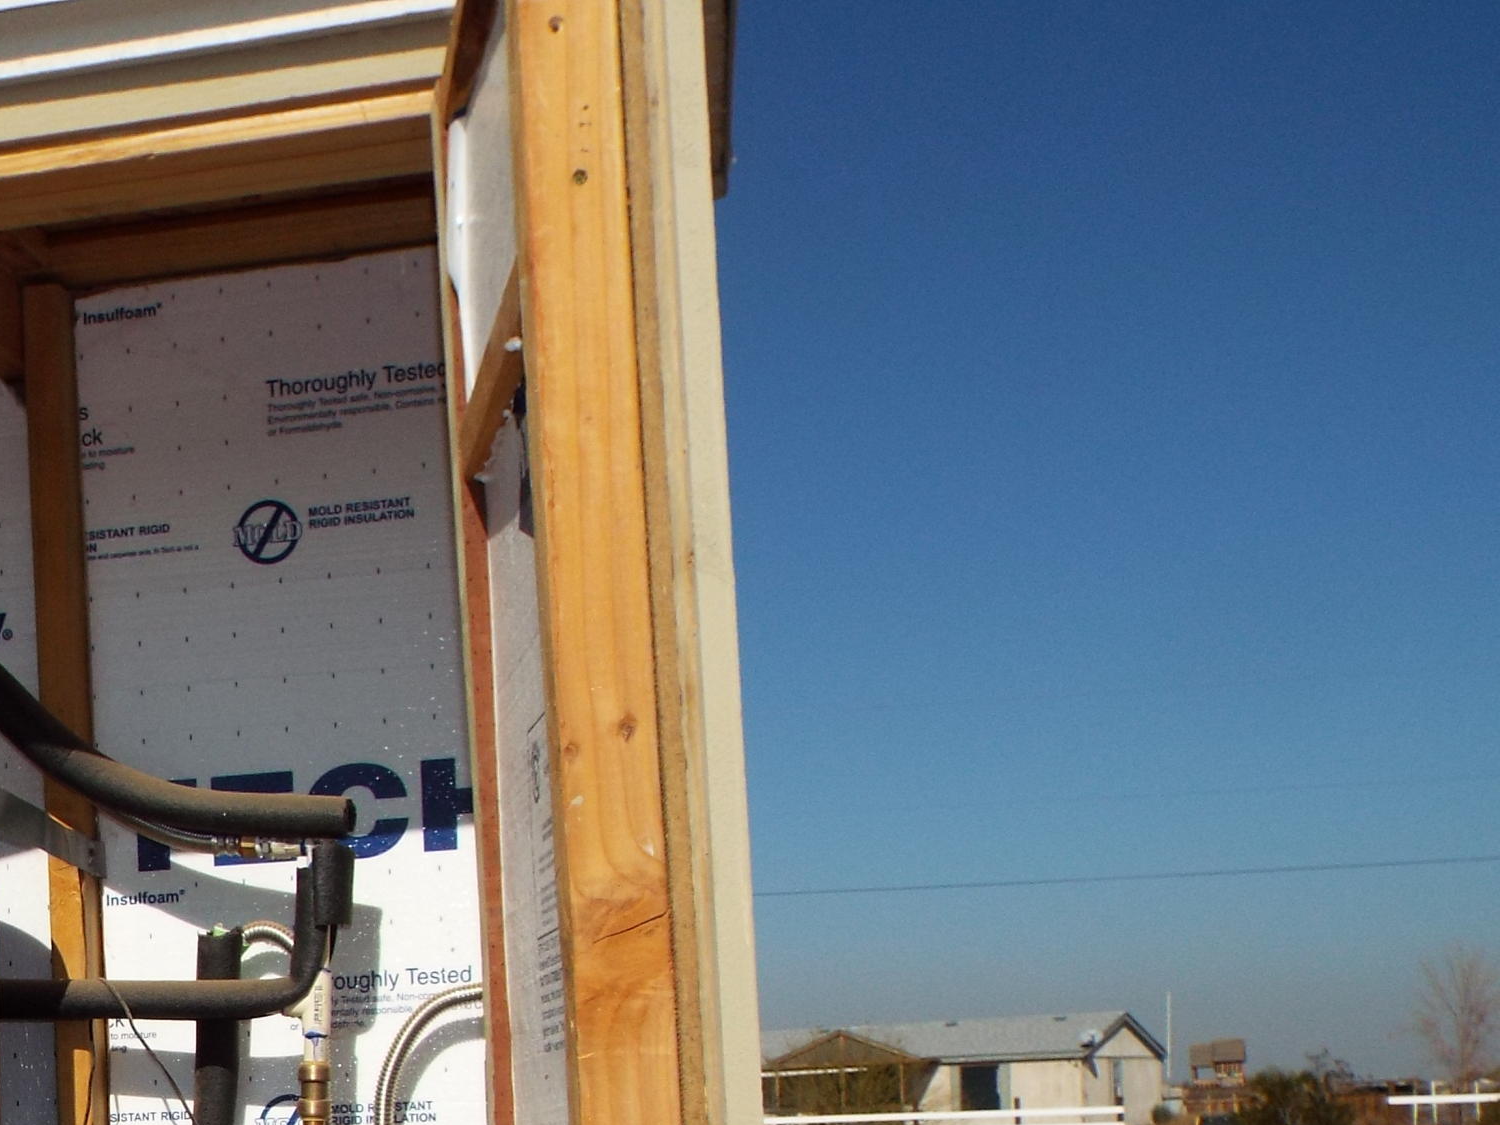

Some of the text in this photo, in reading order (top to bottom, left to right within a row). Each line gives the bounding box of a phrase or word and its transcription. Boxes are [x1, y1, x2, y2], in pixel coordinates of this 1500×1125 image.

[266, 368, 377, 397] Thoroughly
[308, 496, 411, 517] MOLD RESISTANT
[309, 508, 415, 529] RIGID INSULATION
[86, 523, 171, 540] SISTANT RIGID
[106, 889, 182, 907] Insulfoam
[406, 964, 472, 985] Tested
[121, 1030, 157, 1040] moiture
[110, 1110, 191, 1123] SISTANT RIGID
[332, 1103, 364, 1114] MOLD
[332, 1115, 363, 1125] RIGID
